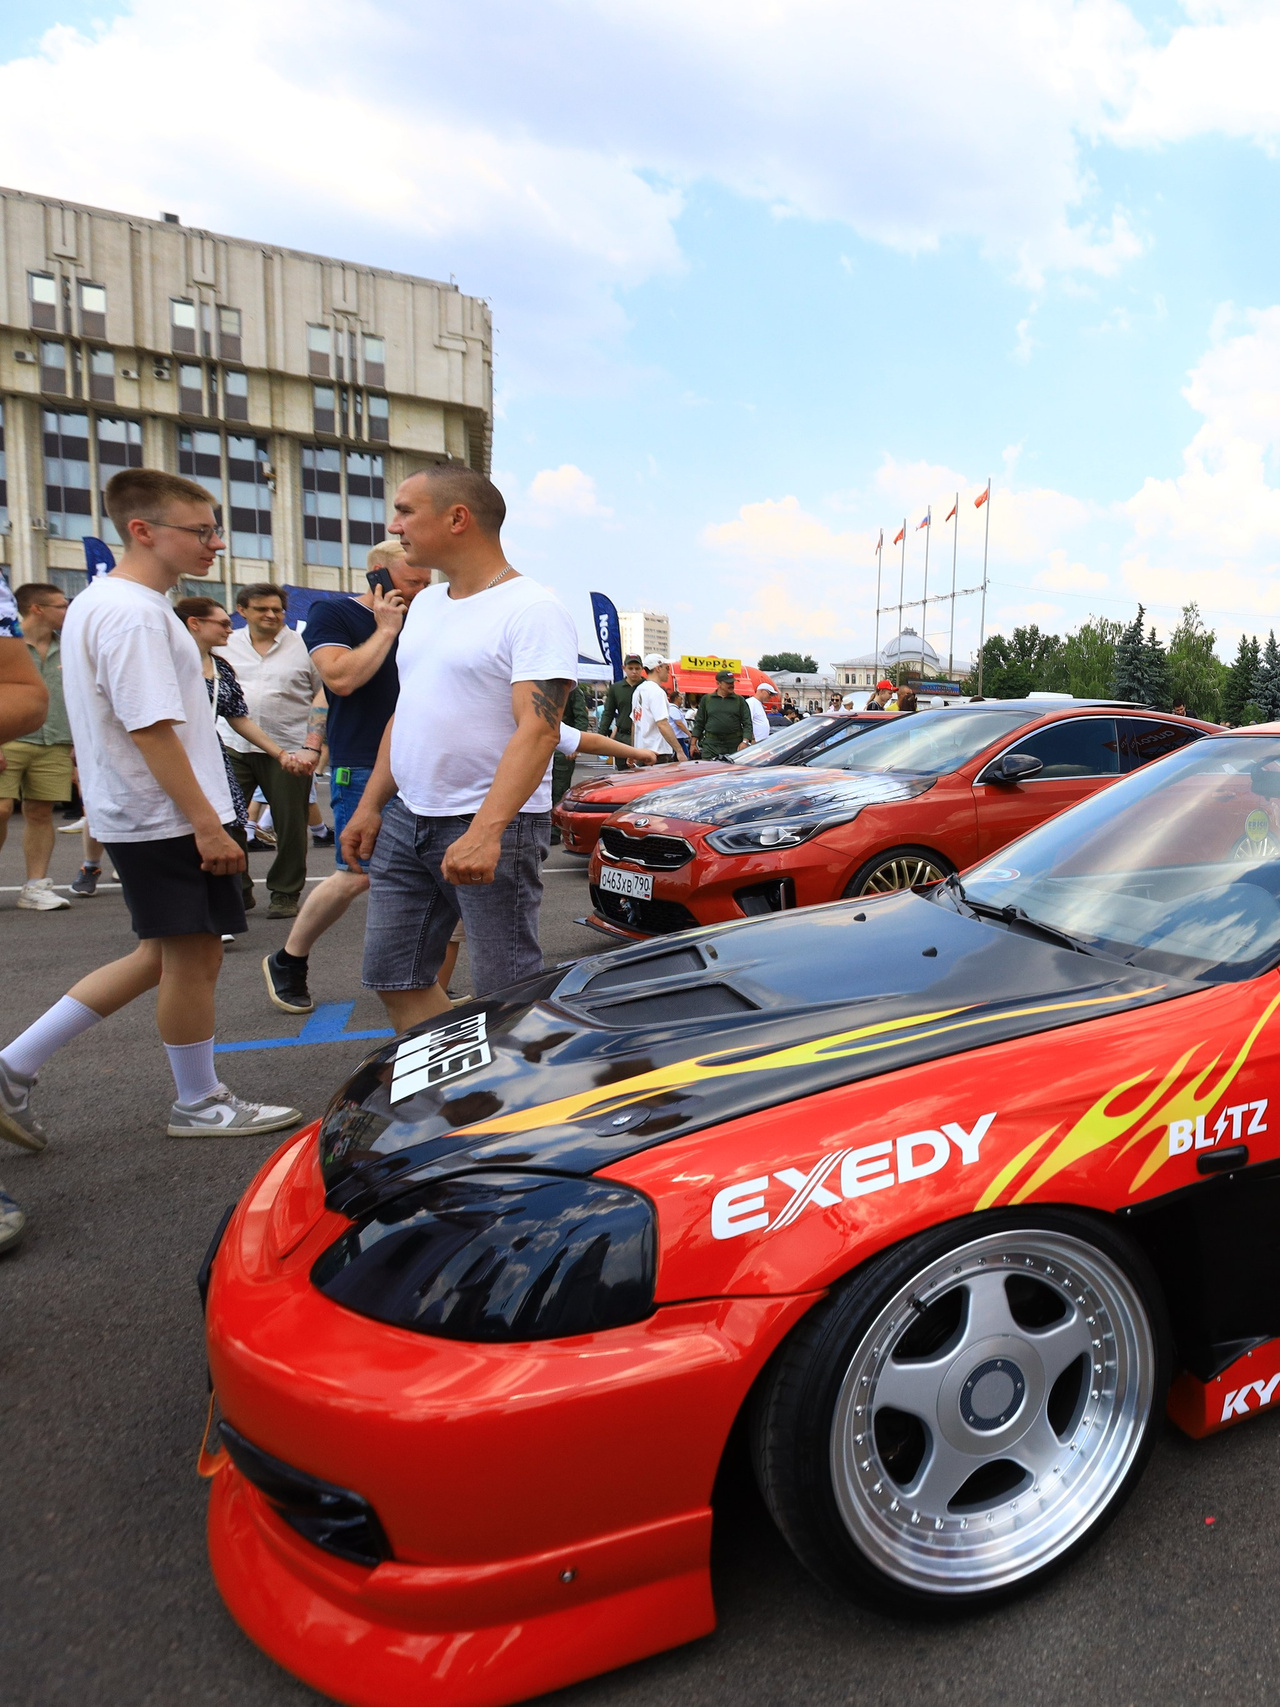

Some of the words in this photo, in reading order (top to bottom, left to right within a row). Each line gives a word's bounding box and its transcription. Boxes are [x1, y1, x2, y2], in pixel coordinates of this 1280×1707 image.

[599, 613, 612, 664] ATON
[634, 876, 650, 892] 790
[1169, 1098, 1268, 1157] BLITZ
[711, 1112, 997, 1240] EXEDY
